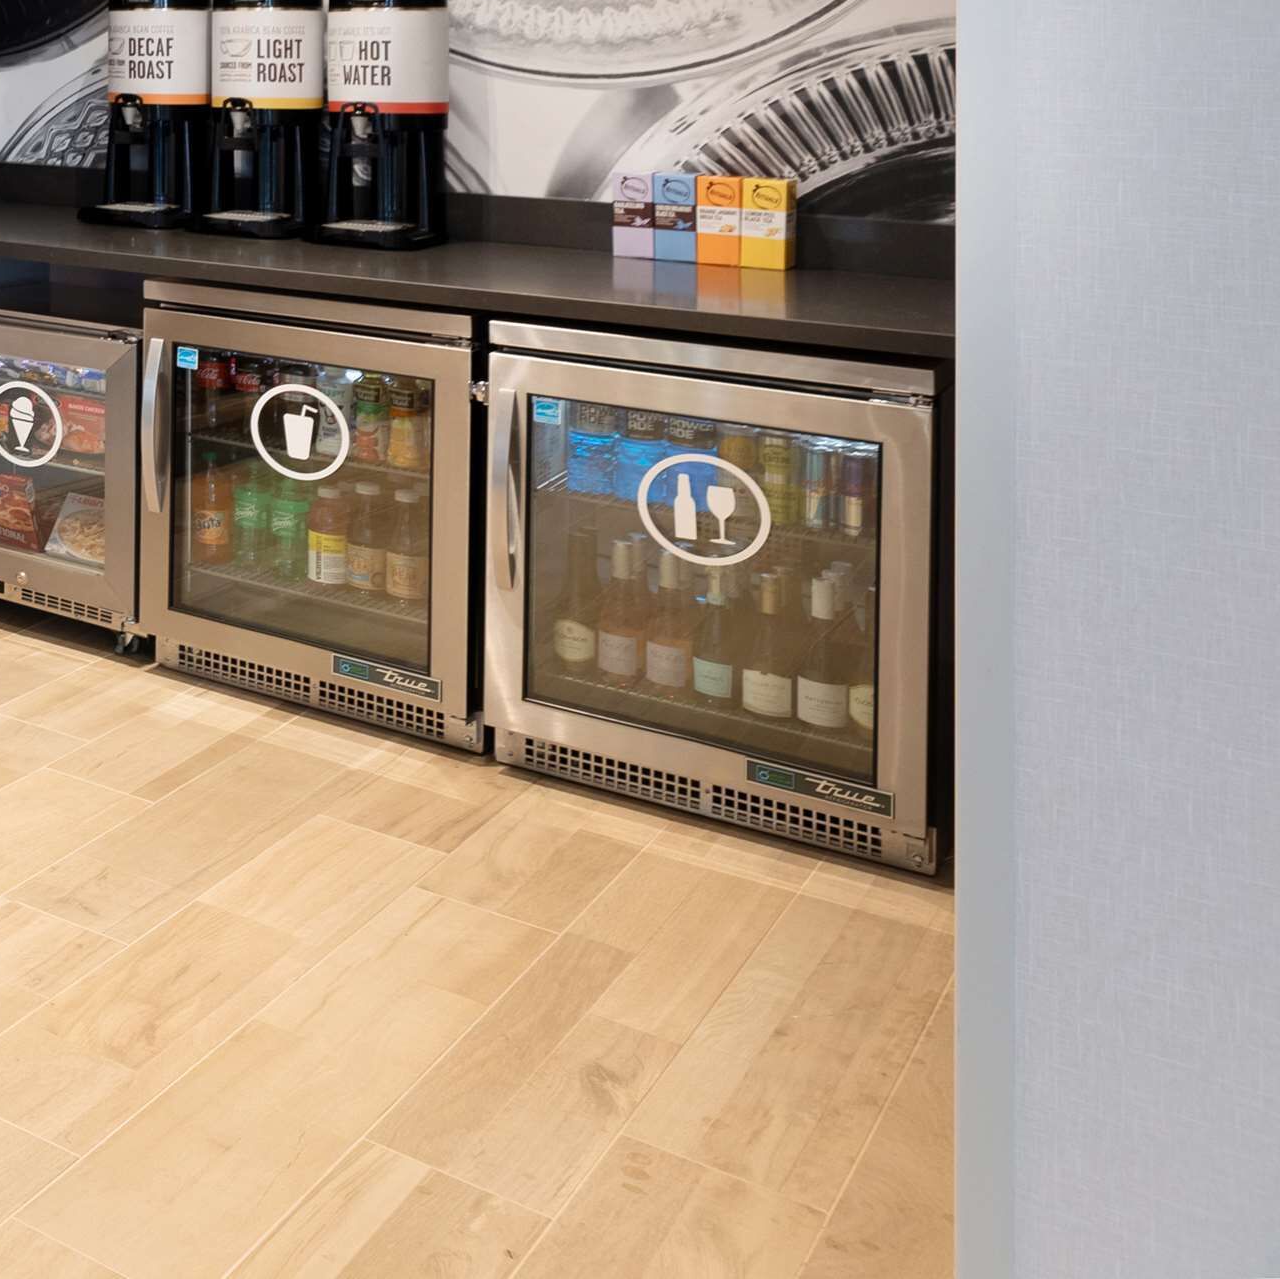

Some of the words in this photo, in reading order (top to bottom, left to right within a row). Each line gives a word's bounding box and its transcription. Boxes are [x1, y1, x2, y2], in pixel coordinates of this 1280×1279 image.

[128, 36, 174, 58] DECAF
[256, 38, 303, 60] LIGHT
[358, 40, 392, 62] HOT
[128, 59, 174, 81] ROAST
[256, 62, 305, 84] ROAST
[343, 64, 392, 87] WATER
[376, 668, 432, 694] true
[804, 776, 881, 807] true
